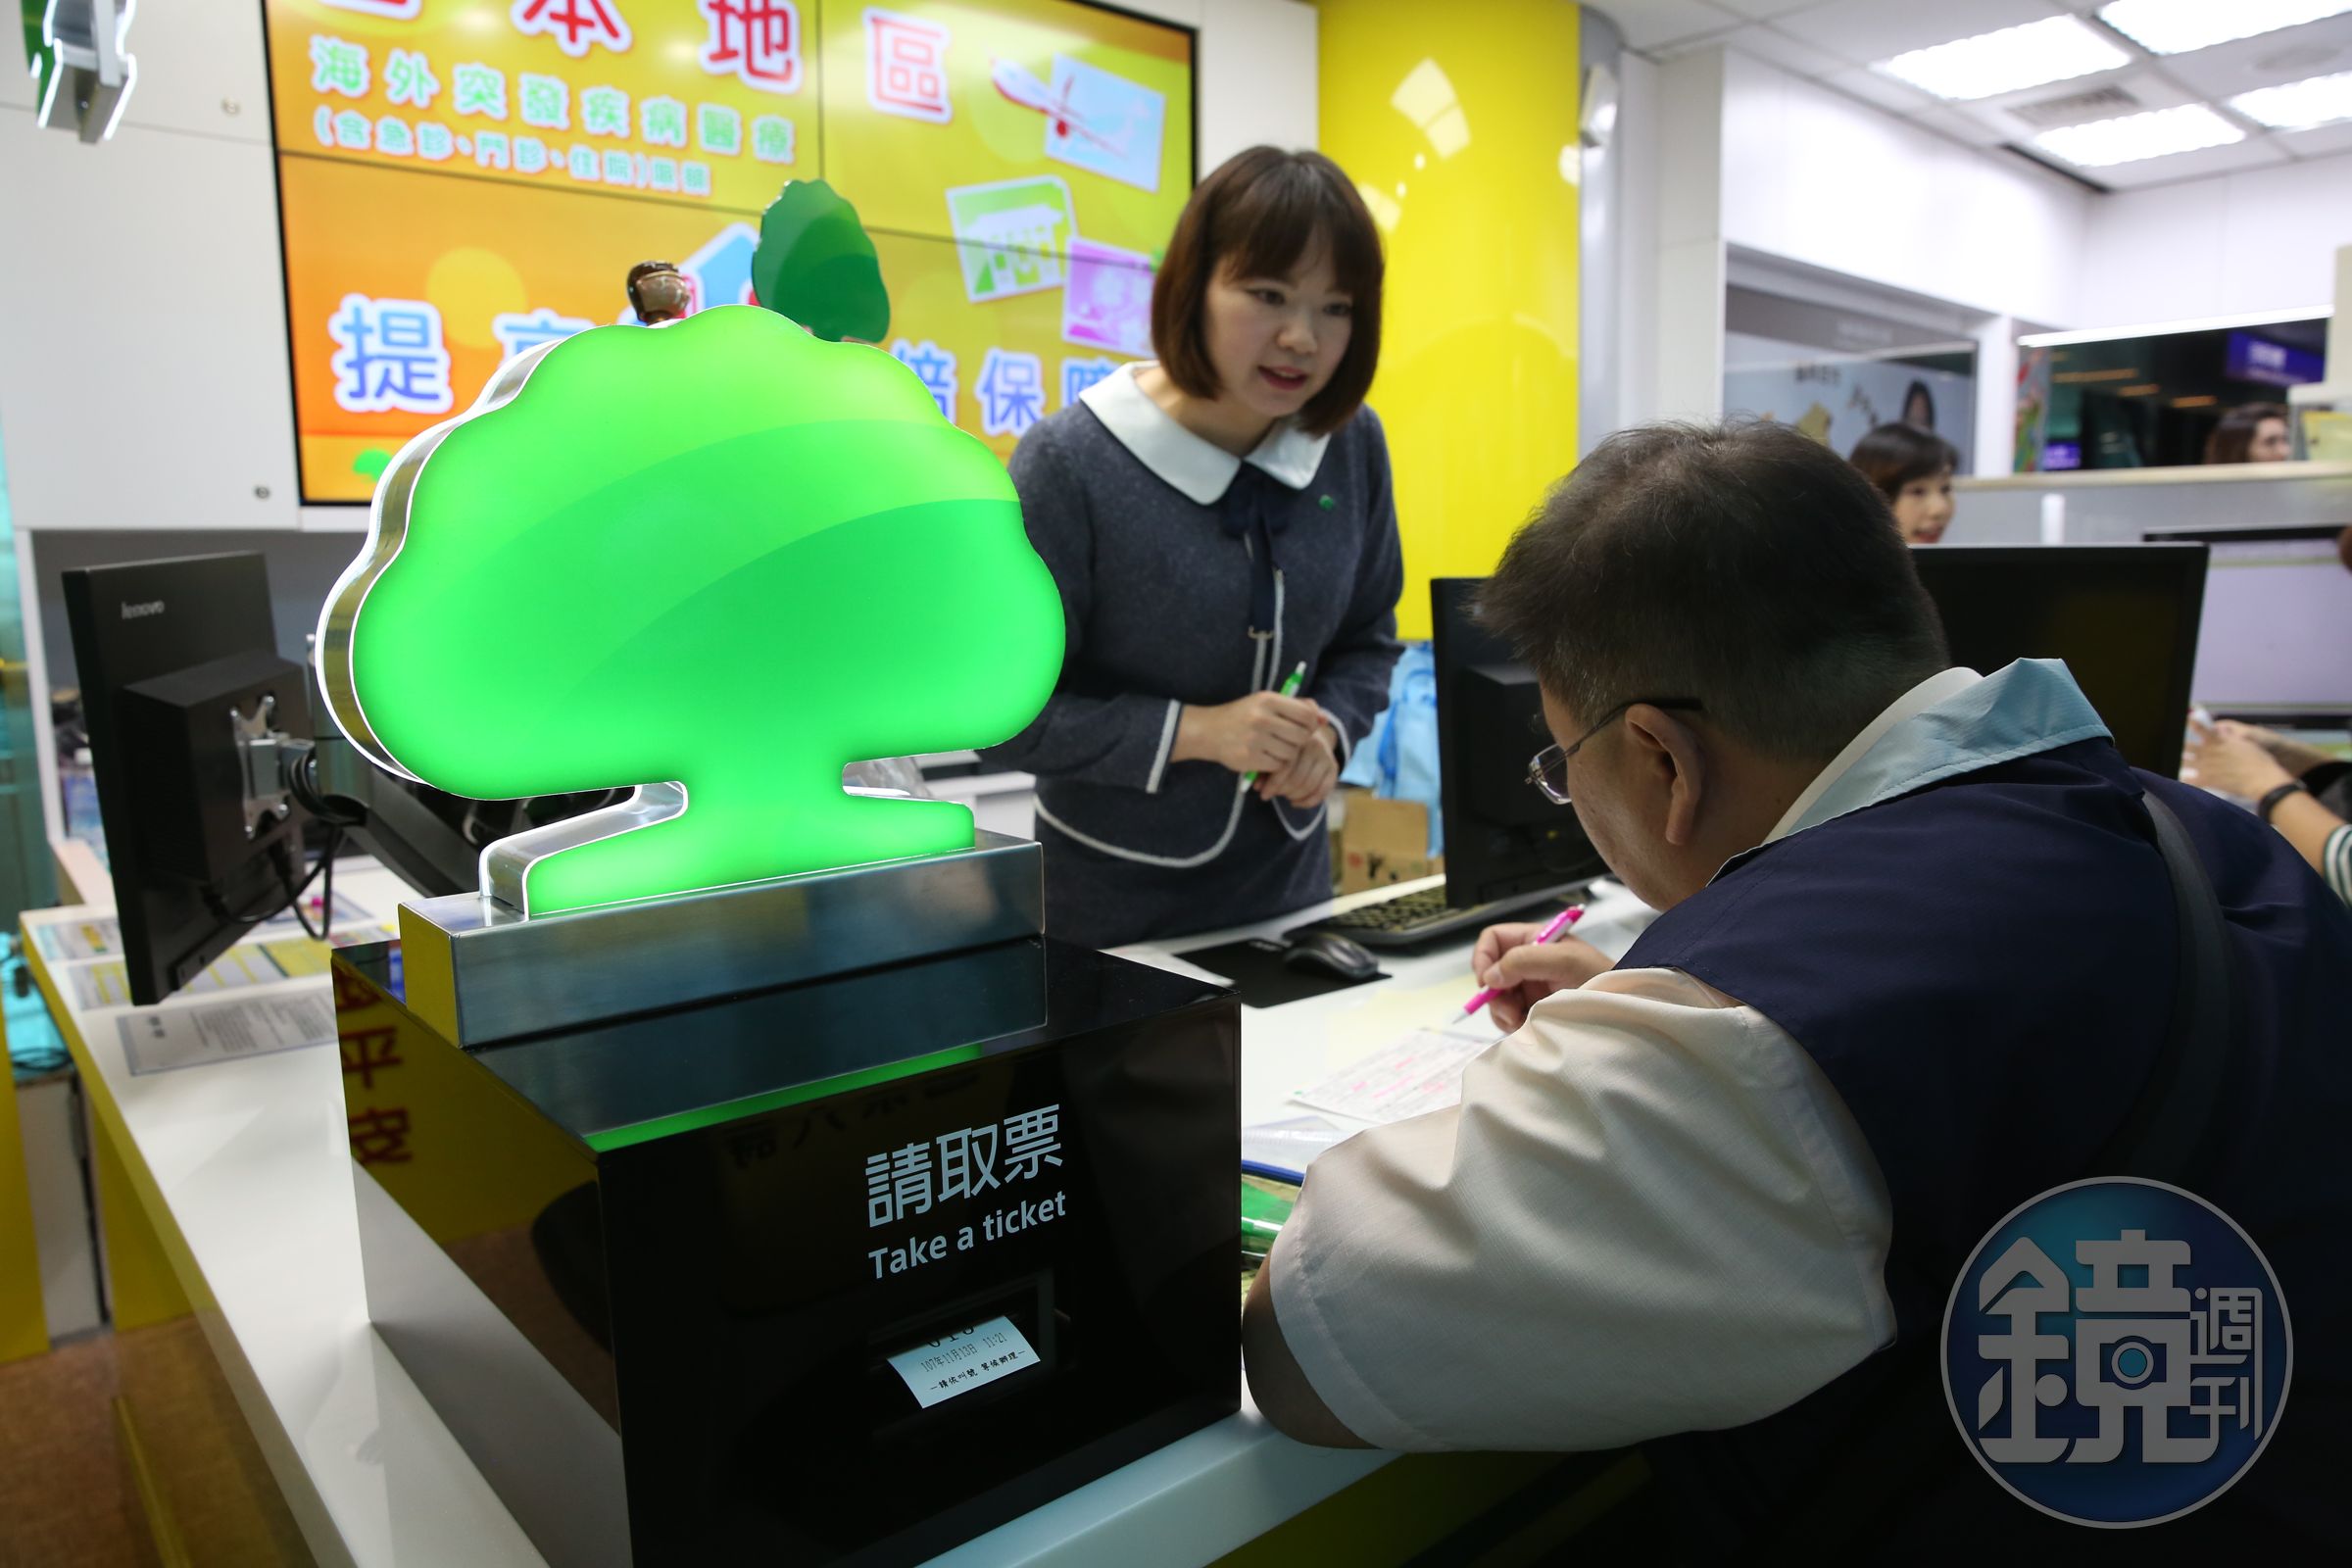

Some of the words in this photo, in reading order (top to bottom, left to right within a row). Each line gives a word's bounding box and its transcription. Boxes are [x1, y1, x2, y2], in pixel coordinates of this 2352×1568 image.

[314, 38, 793, 163] 海外突發疾病醫療
[343, 0, 945, 113] 地區
[121, 600, 165, 619] lenovo
[865, 1103, 1063, 1228] 請取票
[868, 1237, 947, 1279] Take
[956, 1226, 974, 1251] a
[983, 1191, 1066, 1241] ticket
[920, 1344, 978, 1372] 107年11月13日
[982, 1332, 1008, 1348] 11:21
